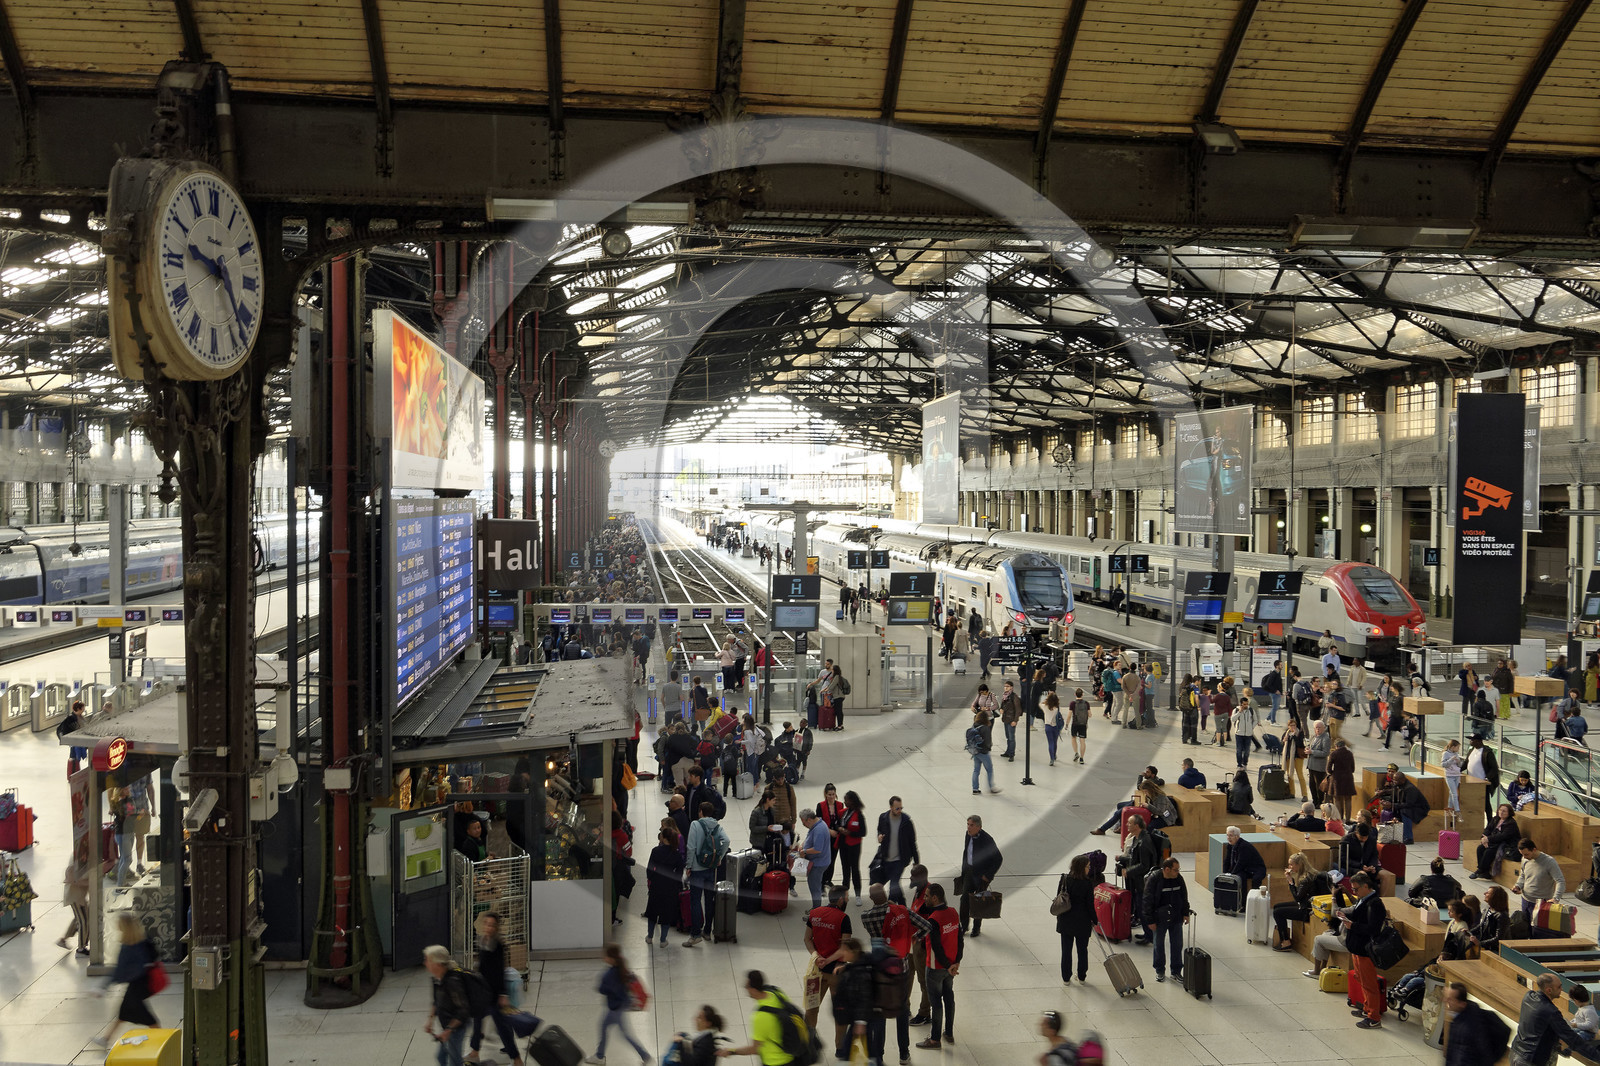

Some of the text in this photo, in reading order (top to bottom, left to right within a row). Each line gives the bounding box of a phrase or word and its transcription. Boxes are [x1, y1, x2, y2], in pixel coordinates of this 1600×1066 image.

[188, 189, 202, 219] XI
[172, 213, 189, 238] X
[1180, 422, 1202, 432] Nouveau
[1180, 434, 1200, 442] T-Cross.
[478, 540, 538, 571] Hall
[570, 556, 579, 566] G
[595, 556, 604, 565] H
[1428, 554, 1437, 562] M
[791, 583, 802, 594] H
[1203, 579, 1212, 590] J
[1276, 578, 1286, 589] K
